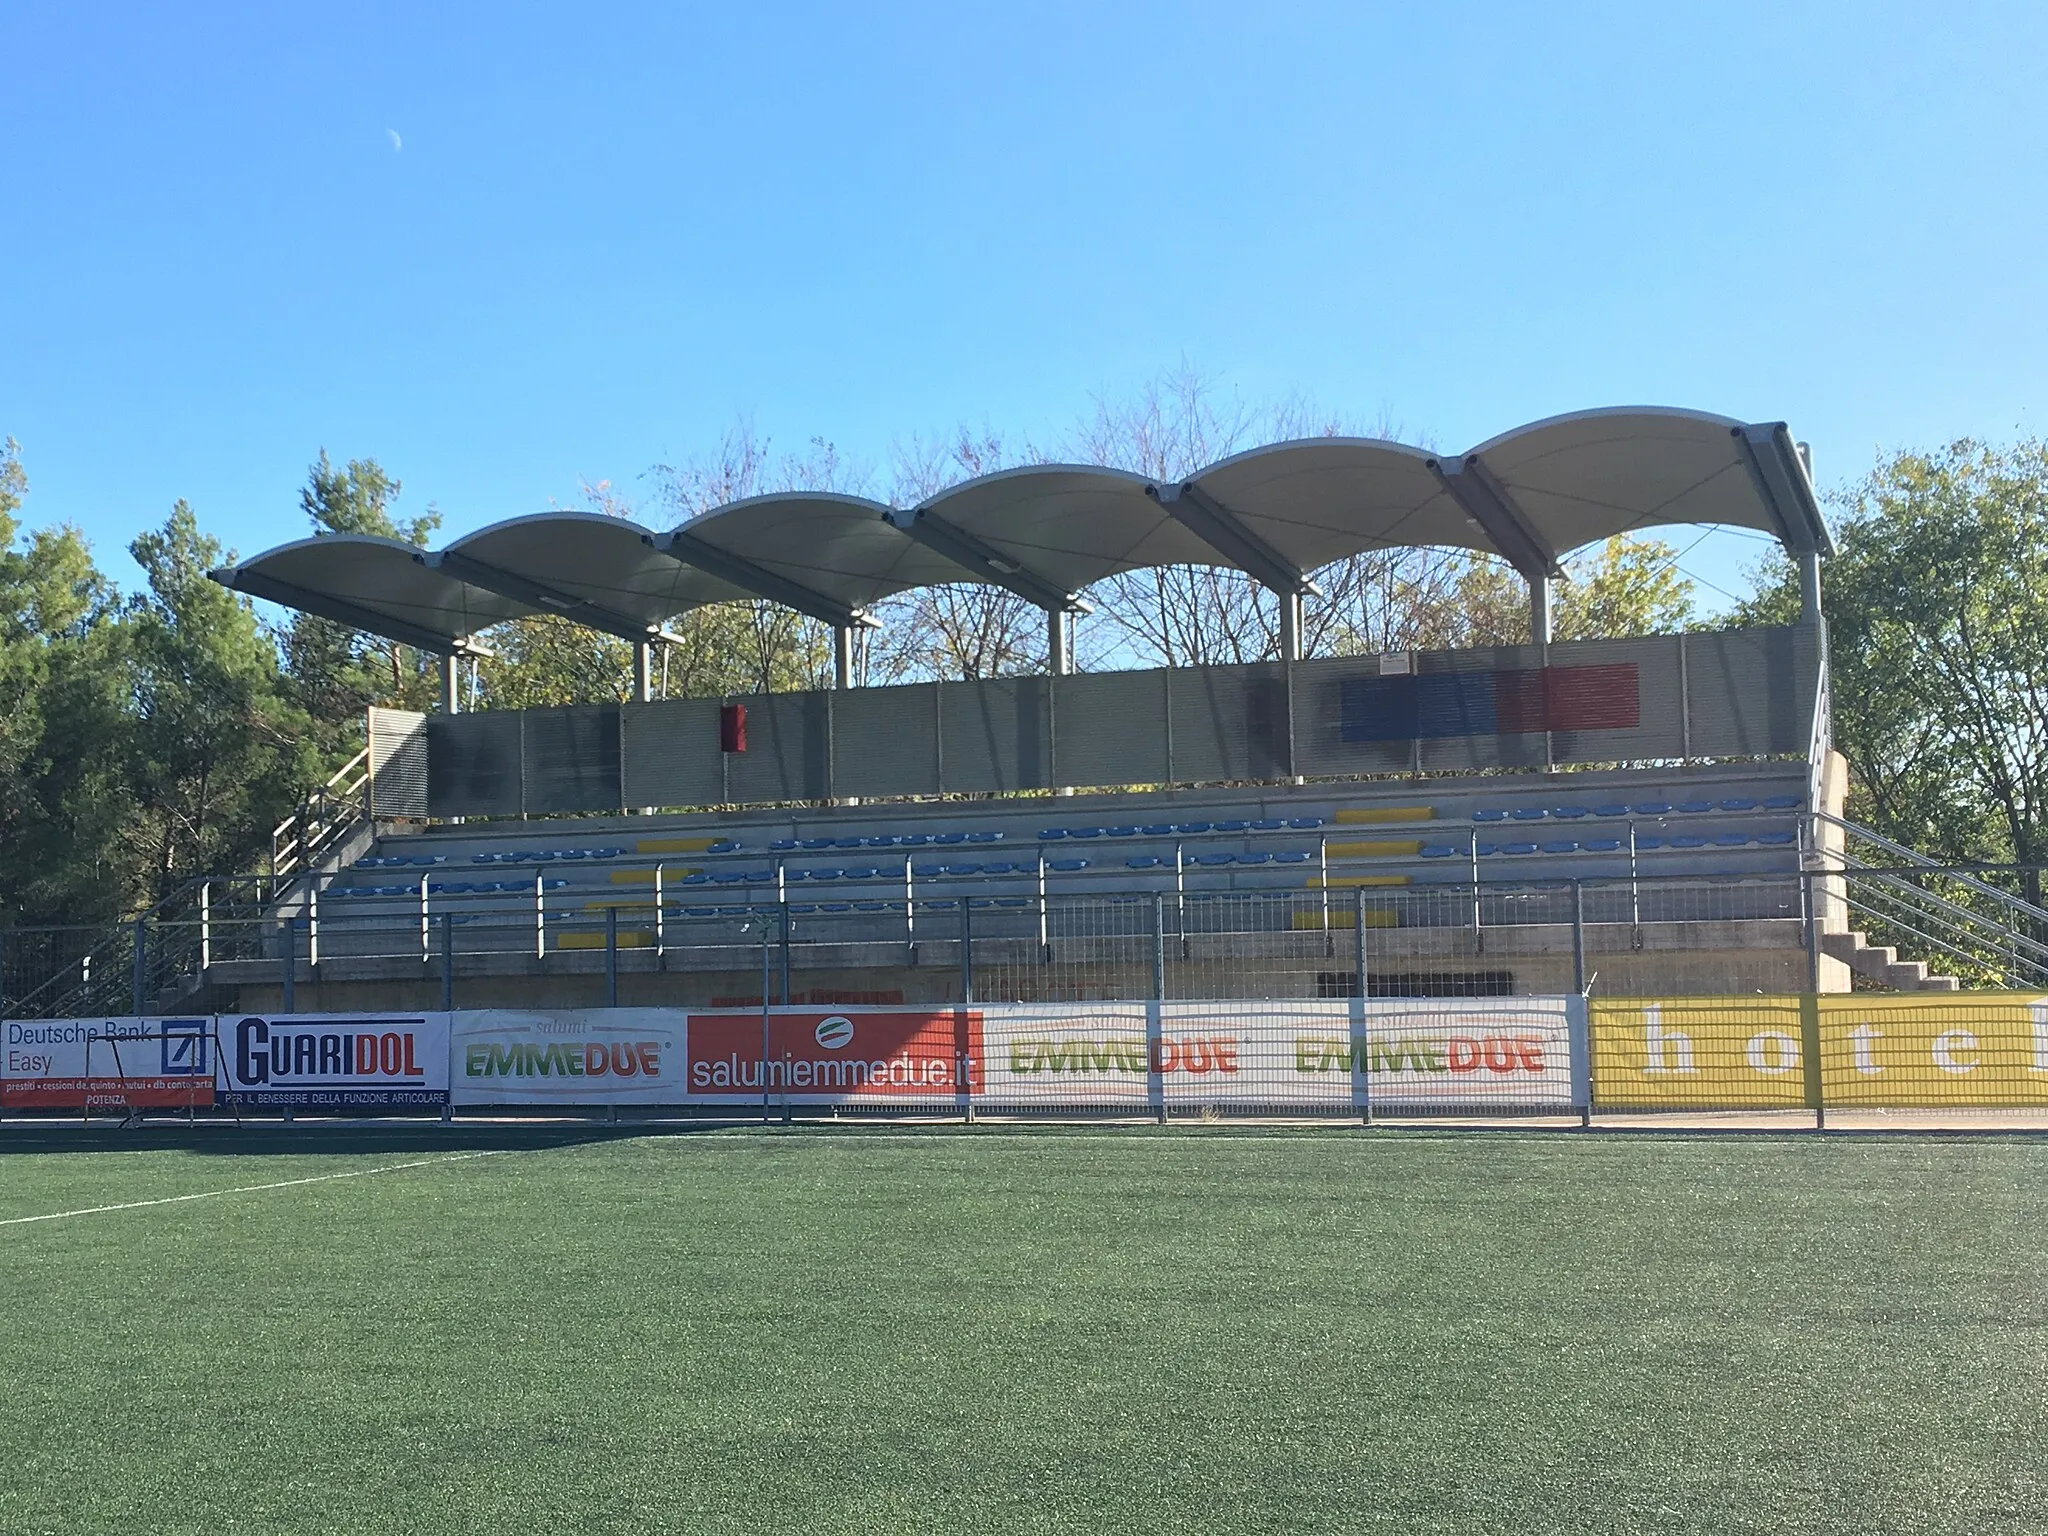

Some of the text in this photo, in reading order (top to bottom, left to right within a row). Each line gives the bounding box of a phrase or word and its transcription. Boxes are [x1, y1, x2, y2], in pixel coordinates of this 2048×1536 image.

[9, 1021, 152, 1044] Deutsche Bank
[535, 1019, 588, 1035] salumi
[9, 1050, 53, 1076] Easy
[236, 1017, 424, 1086] GUARIDOL
[465, 1042, 661, 1078] EMMEDUE
[1009, 1037, 1240, 1076] EMMEDUE
[1295, 1034, 1547, 1074] EMMEDUE
[692, 1051, 977, 1087] salumiemmedue.it
[6, 1081, 36, 1093] prestiti
[42, 1080, 76, 1090] cessioni
[90, 1081, 117, 1092] quinto
[153, 1080, 166, 1089] db
[86, 1094, 126, 1105] POTENZA
[258, 1093, 308, 1104] BENESSERE
[312, 1093, 341, 1104] DELLA
[344, 1093, 388, 1103] FUNZIONE
[391, 1092, 445, 1103] ARTICOLARE
